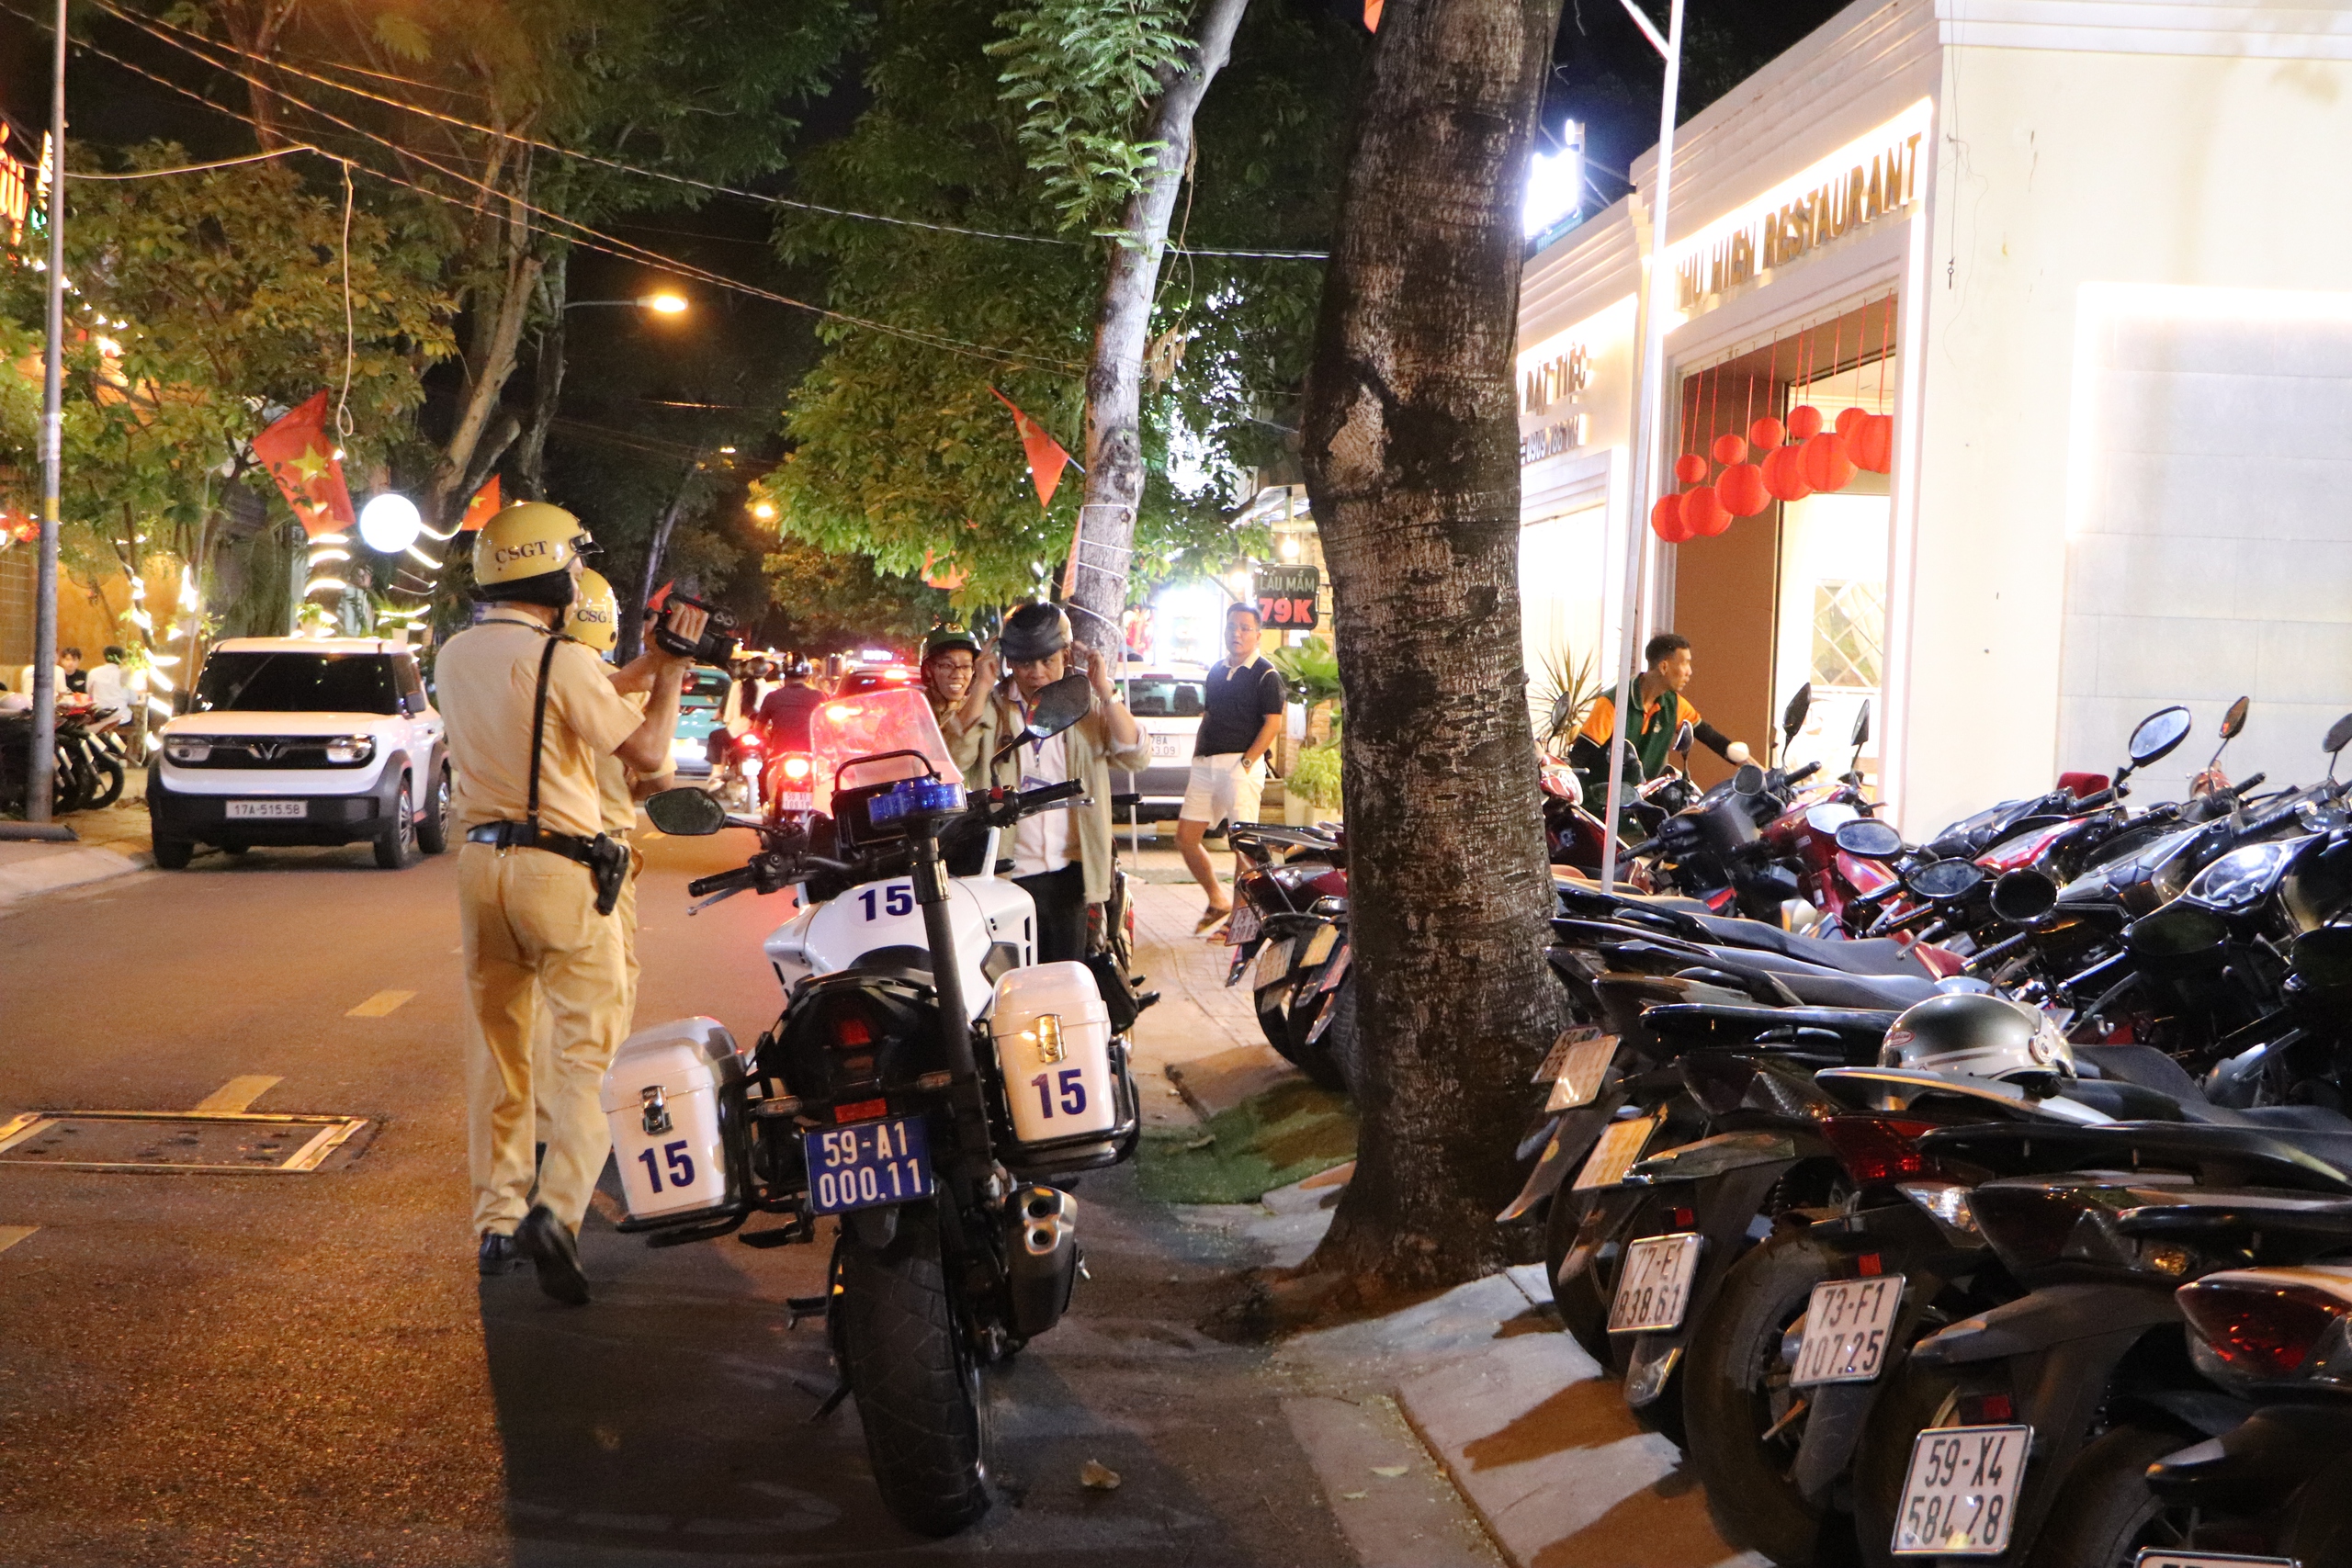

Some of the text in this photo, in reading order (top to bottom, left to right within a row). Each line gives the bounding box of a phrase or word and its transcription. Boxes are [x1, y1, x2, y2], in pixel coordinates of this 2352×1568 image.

[1762, 131, 1922, 270] RESTAURANT
[494, 540, 548, 564] CSGT
[1260, 570, 1316, 592] LẨU MẮM
[1259, 597, 1315, 624] 79K
[858, 885, 913, 922] 15
[1031, 1068, 1087, 1119] 15
[638, 1139, 695, 1194] 15
[822, 1121, 908, 1168] 59-A1
[819, 1157, 922, 1208] 000.11
[1819, 1282, 1885, 1329] 73-F1
[1801, 1328, 1883, 1379] 107.25
[1925, 1436, 2006, 1487] 59-X4
